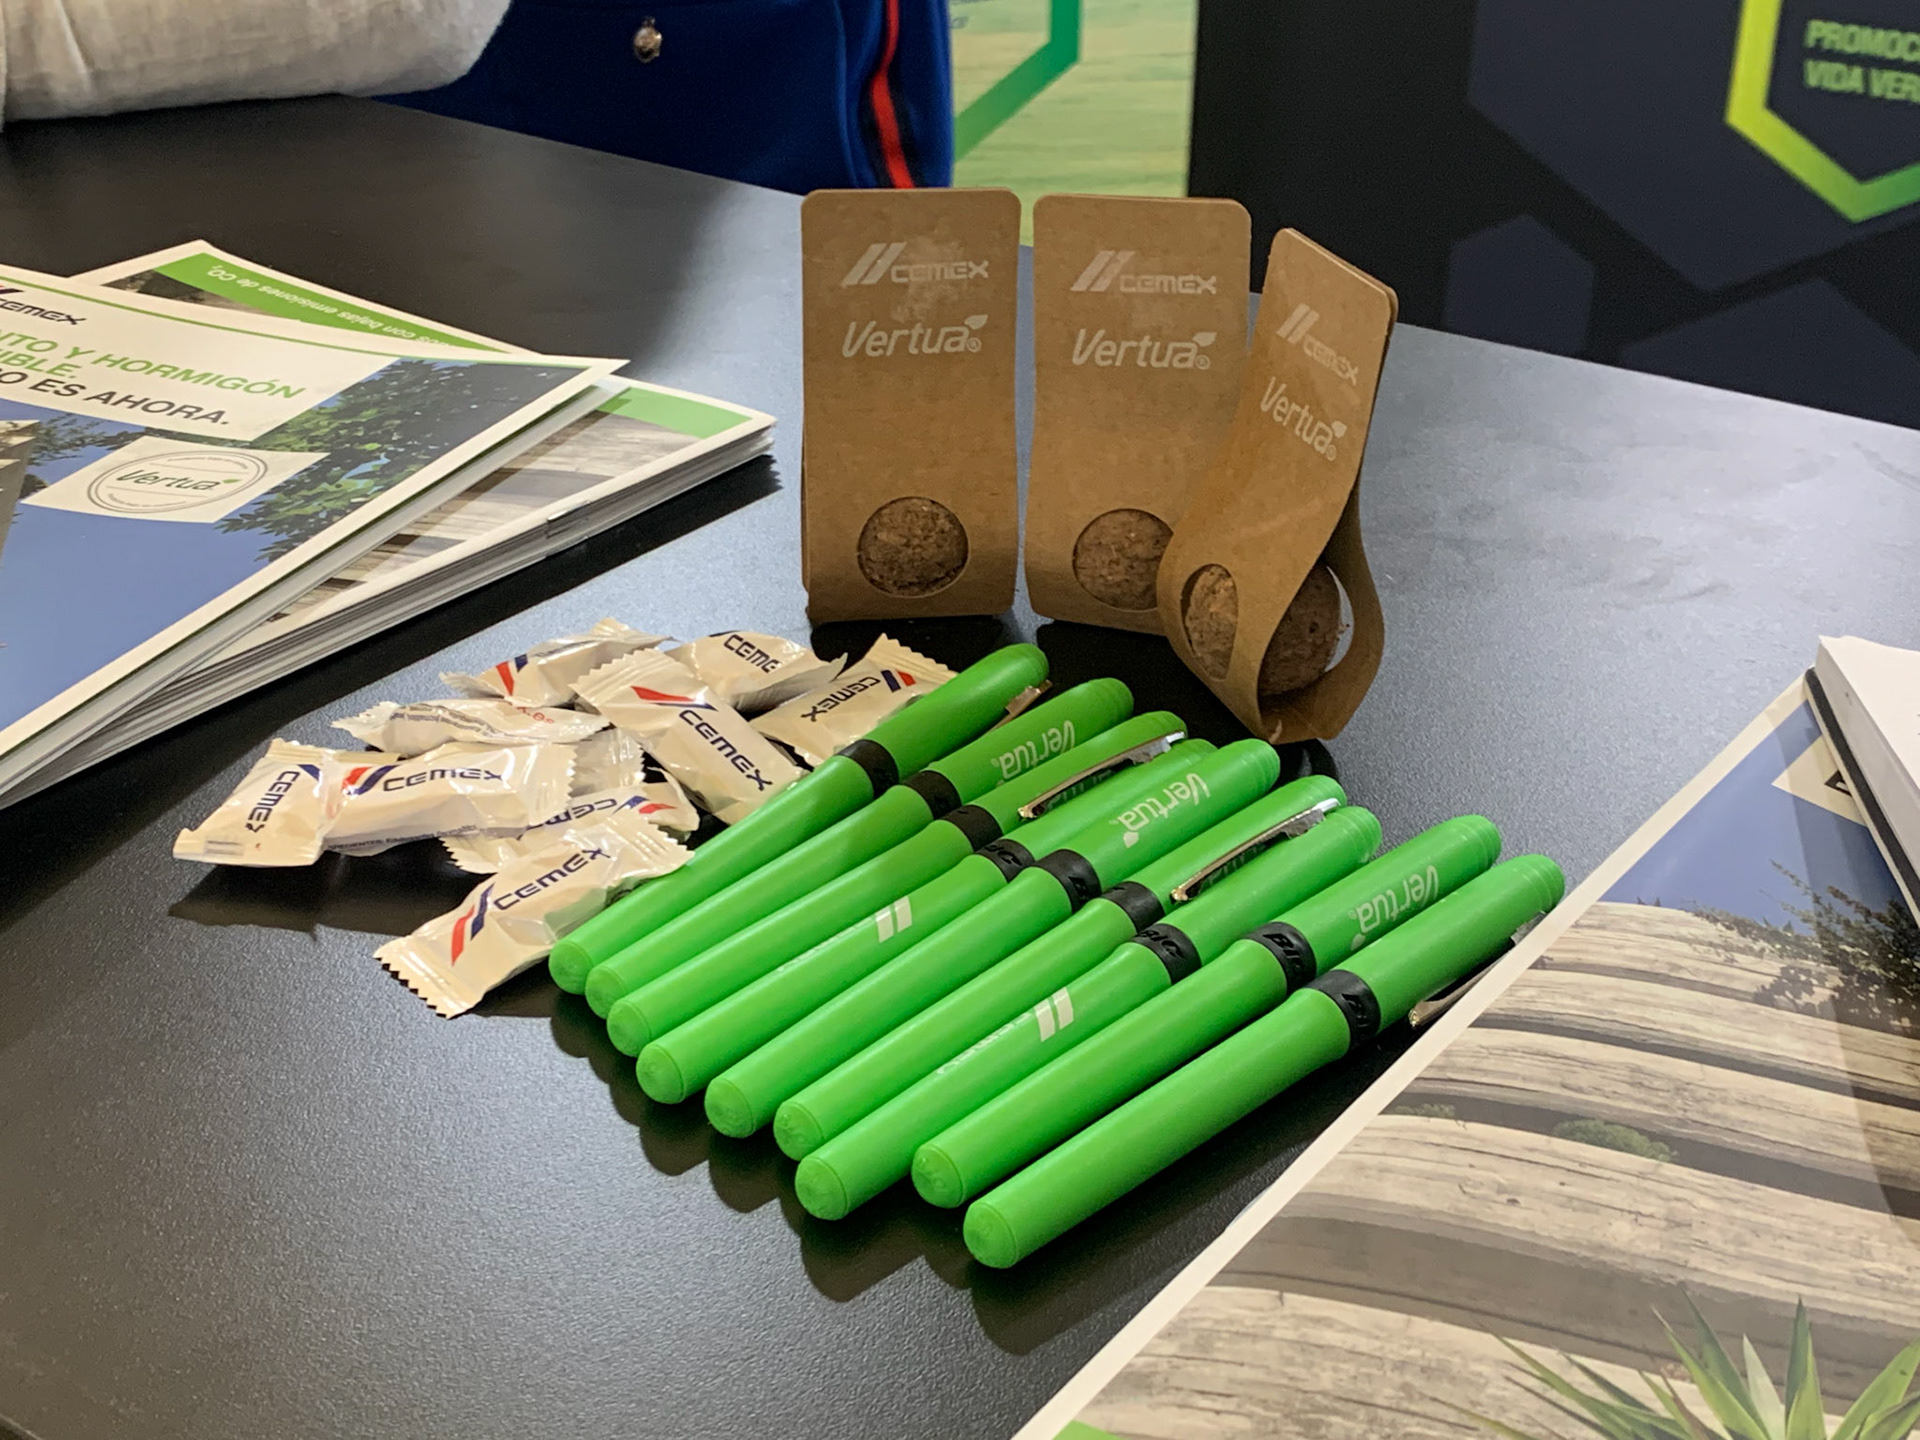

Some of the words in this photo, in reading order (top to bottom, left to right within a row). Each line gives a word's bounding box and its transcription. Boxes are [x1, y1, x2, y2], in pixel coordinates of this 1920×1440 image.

[1804, 58, 1863, 93] VIDA
[236, 278, 260, 288] de
[890, 260, 989, 283] CEMEX
[1119, 274, 1217, 295] CEMEX
[258, 285, 338, 313] emisiones
[382, 325, 416, 339] con
[0, 349, 82, 378] IBLE.
[64, 346, 96, 359] Y
[90, 354, 307, 399] HORMIGÓN
[28, 378, 87, 397] ES
[82, 391, 229, 425] AHORA.
[723, 634, 781, 674] CEME
[801, 676, 881, 722] CEMEX
[679, 709, 773, 791] CEMEX
[493, 848, 611, 911] CEMEX
